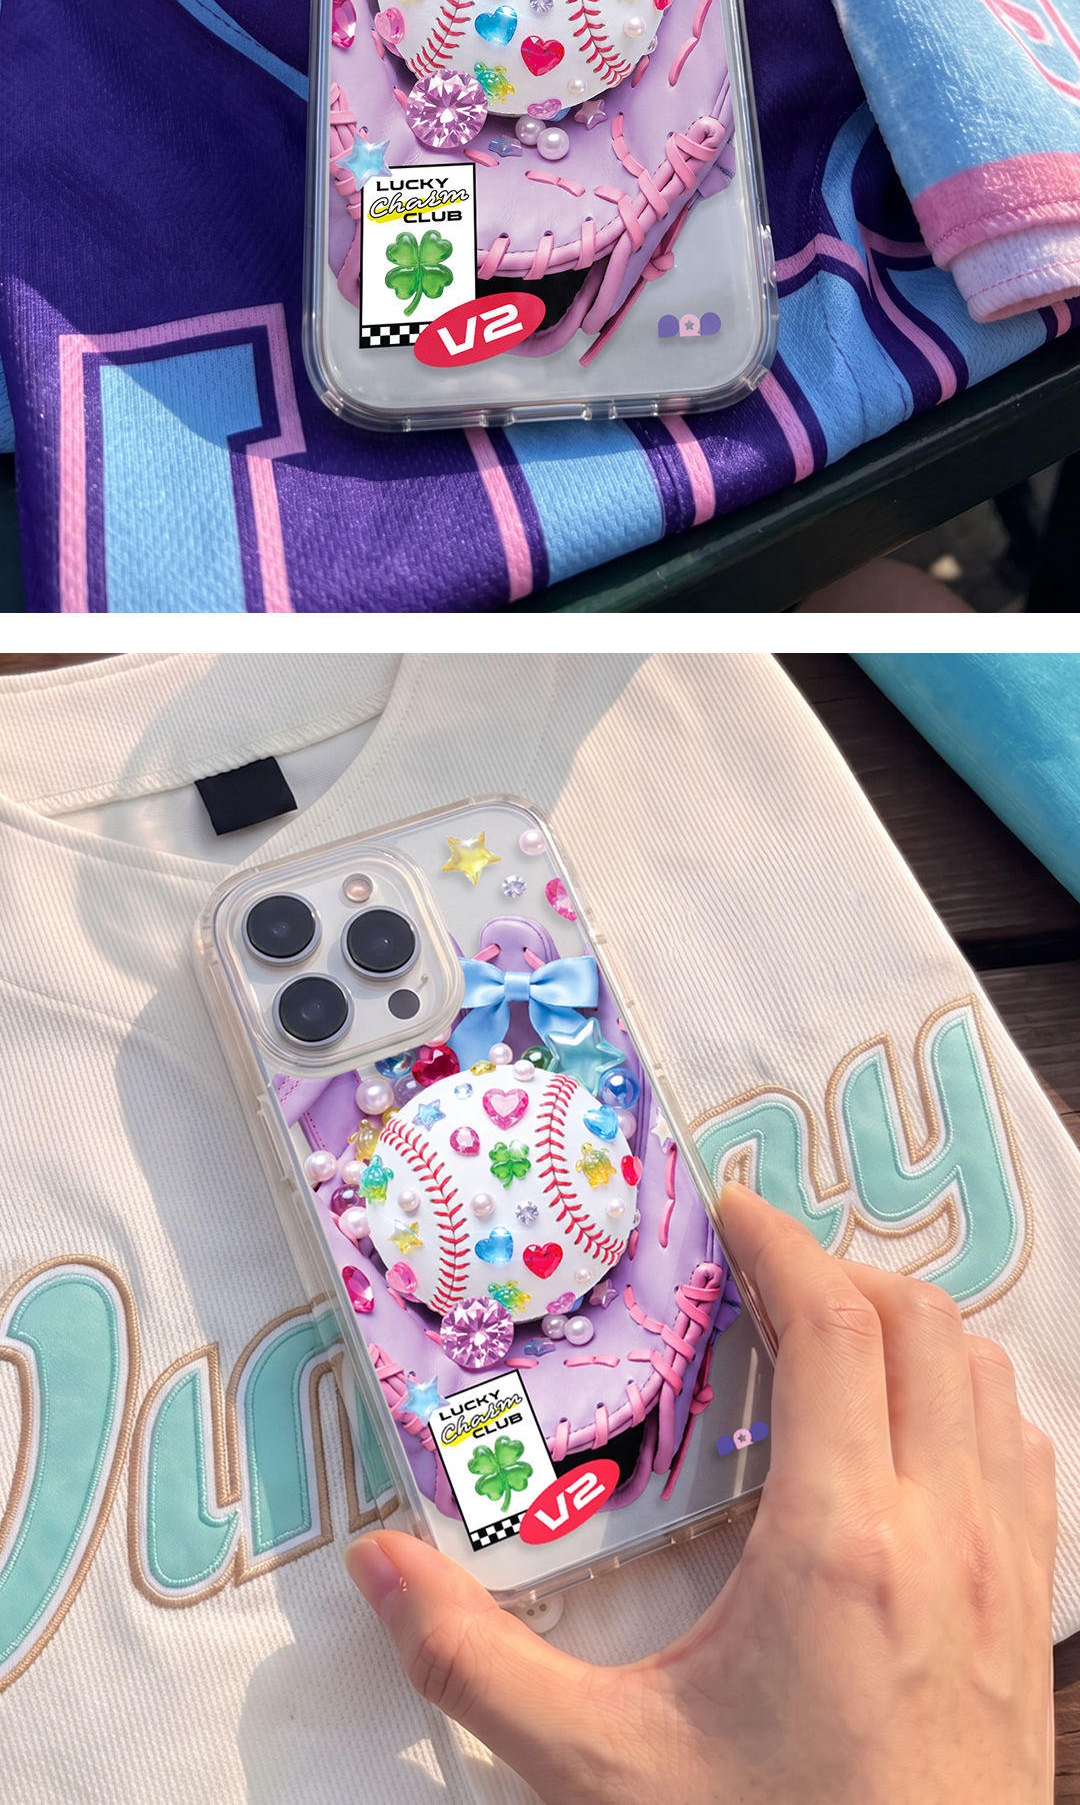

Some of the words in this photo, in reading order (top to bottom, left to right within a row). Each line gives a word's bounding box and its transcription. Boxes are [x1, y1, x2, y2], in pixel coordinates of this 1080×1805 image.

[376, 178, 449, 191] LUCKY
[369, 189, 469, 218] Charm
[403, 210, 463, 223] CLUB
[437, 304, 524, 356] V2
[439, 1389, 500, 1421] LUCKY
[441, 1394, 523, 1445] Charm
[472, 1412, 523, 1439] CLUB
[534, 1472, 606, 1531] V2
